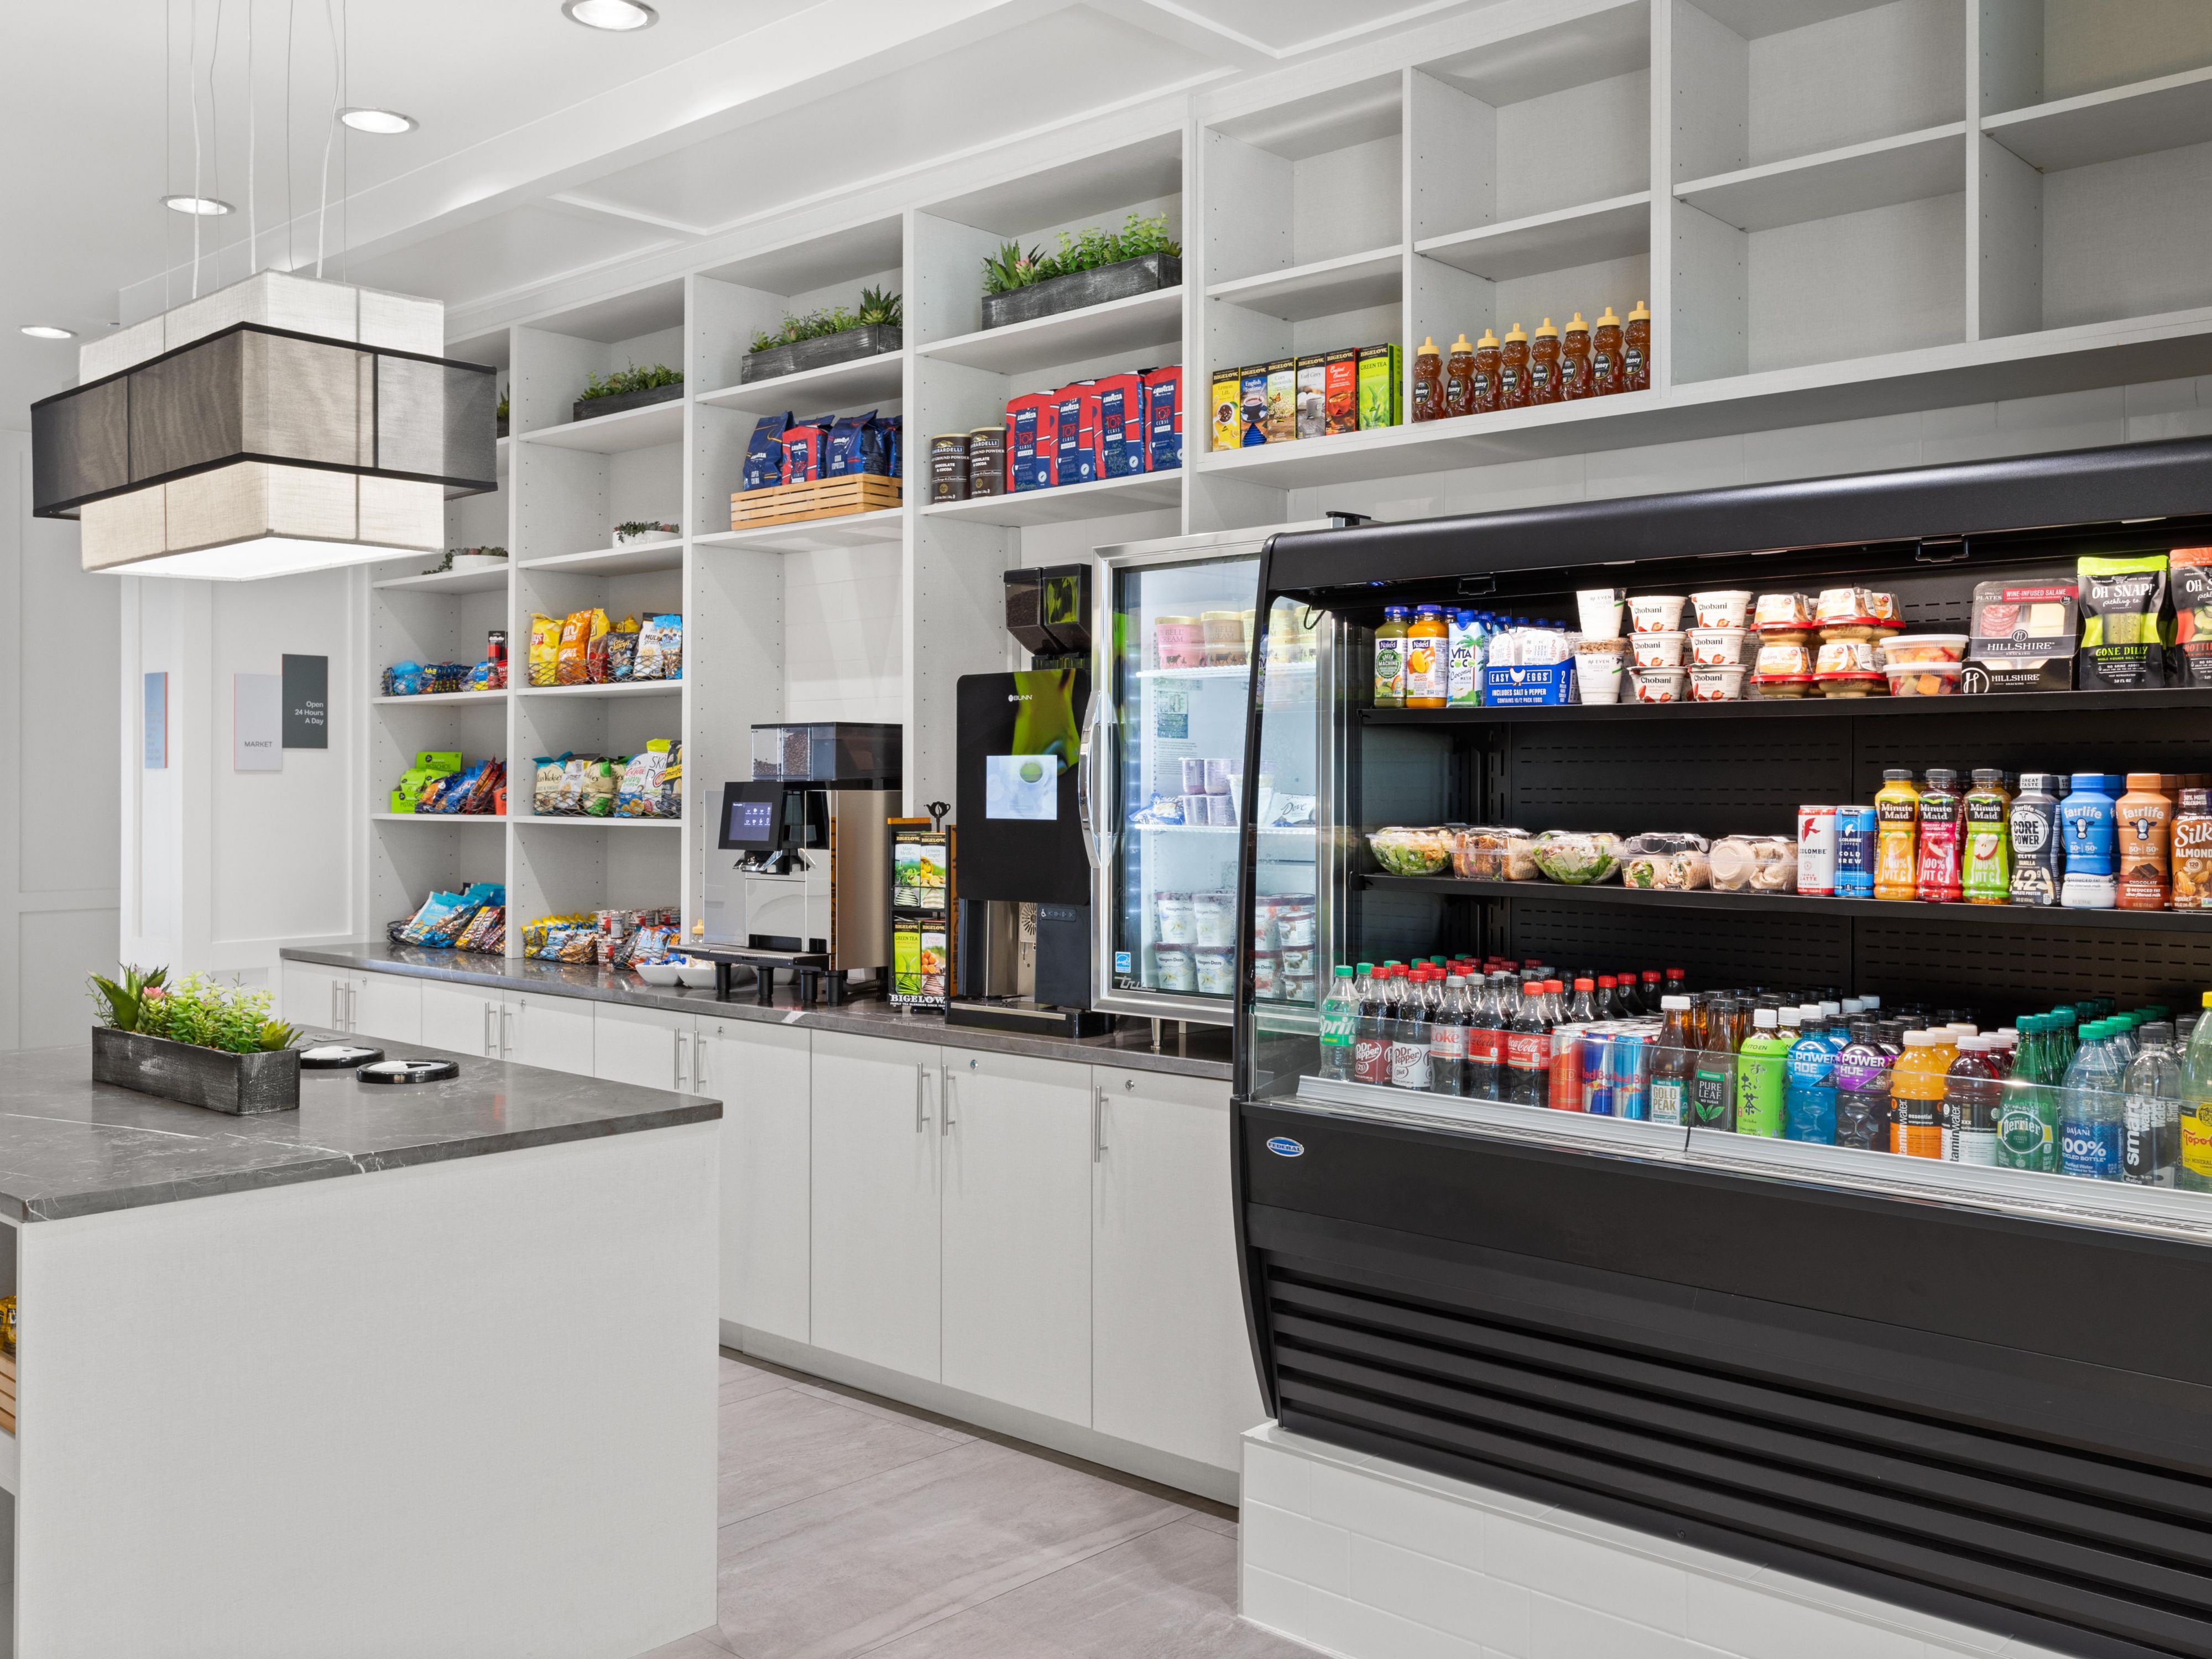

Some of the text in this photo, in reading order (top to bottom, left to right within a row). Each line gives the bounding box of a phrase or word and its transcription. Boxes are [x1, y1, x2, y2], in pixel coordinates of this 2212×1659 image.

[1327, 352, 1353, 361] BIGELOW
[1360, 347, 1387, 357] BIGELOW
[1269, 362, 1293, 371] BIGELOW
[1298, 358, 1324, 366] BIGELOW
[1241, 368, 1266, 376] BIGELOW
[1153, 385, 1174, 394] LAVAZZA
[1103, 394, 1123, 403] LAVAZZA
[1060, 404, 1079, 413] LAVAZZA
[1018, 411, 1036, 420] LAVAZZA
[2092, 584, 2152, 598] OH SNAP!
[2186, 580, 2202, 593] OH
[2103, 598, 2130, 607] pickling
[1987, 643, 2052, 651] HILLSHIRE
[2096, 646, 2148, 656] GONE DILLY
[1451, 648, 1472, 659] VITA
[1450, 659, 1475, 668] COCO
[1491, 674, 1509, 682] EASY
[1527, 672, 1547, 681] EGGS
[1562, 670, 1565, 684] 2
[1881, 803, 1913, 812] Minute
[1920, 804, 1952, 812] Minute
[1970, 804, 2001, 812] Minute
[1885, 811, 1909, 820] Maid
[2013, 821, 2039, 834] CORE
[2015, 834, 2039, 845] POWER
[2174, 822, 2212, 847] Silk
[2176, 848, 2212, 858] ALMOND
[1885, 870, 1897, 880] VIT
[1923, 871, 1936, 881] VIT
[1975, 872, 1987, 882] VIT
[1431, 1028, 1460, 1044] Coke
[1356, 1044, 1379, 1061] Pepper
[1395, 1048, 1420, 1065] Pepper
[1842, 1053, 1885, 1067] POWER
[1794, 1062, 1817, 1073] ADE
[1699, 1081, 1721, 1092] PURE
[1653, 1087, 1677, 1099] GOLD
[1699, 1089, 1721, 1099] LEAF
[1741, 1073, 1762, 1115] お茶
[1653, 1099, 1676, 1110] PEAK
[2004, 1118, 2041, 1141] perrier
[2126, 1097, 2141, 1166] smart
[2183, 1128, 2208, 1146] Topo
[1269, 1142, 1301, 1151] FEDERAL
[2063, 1137, 2106, 1156] 100%
